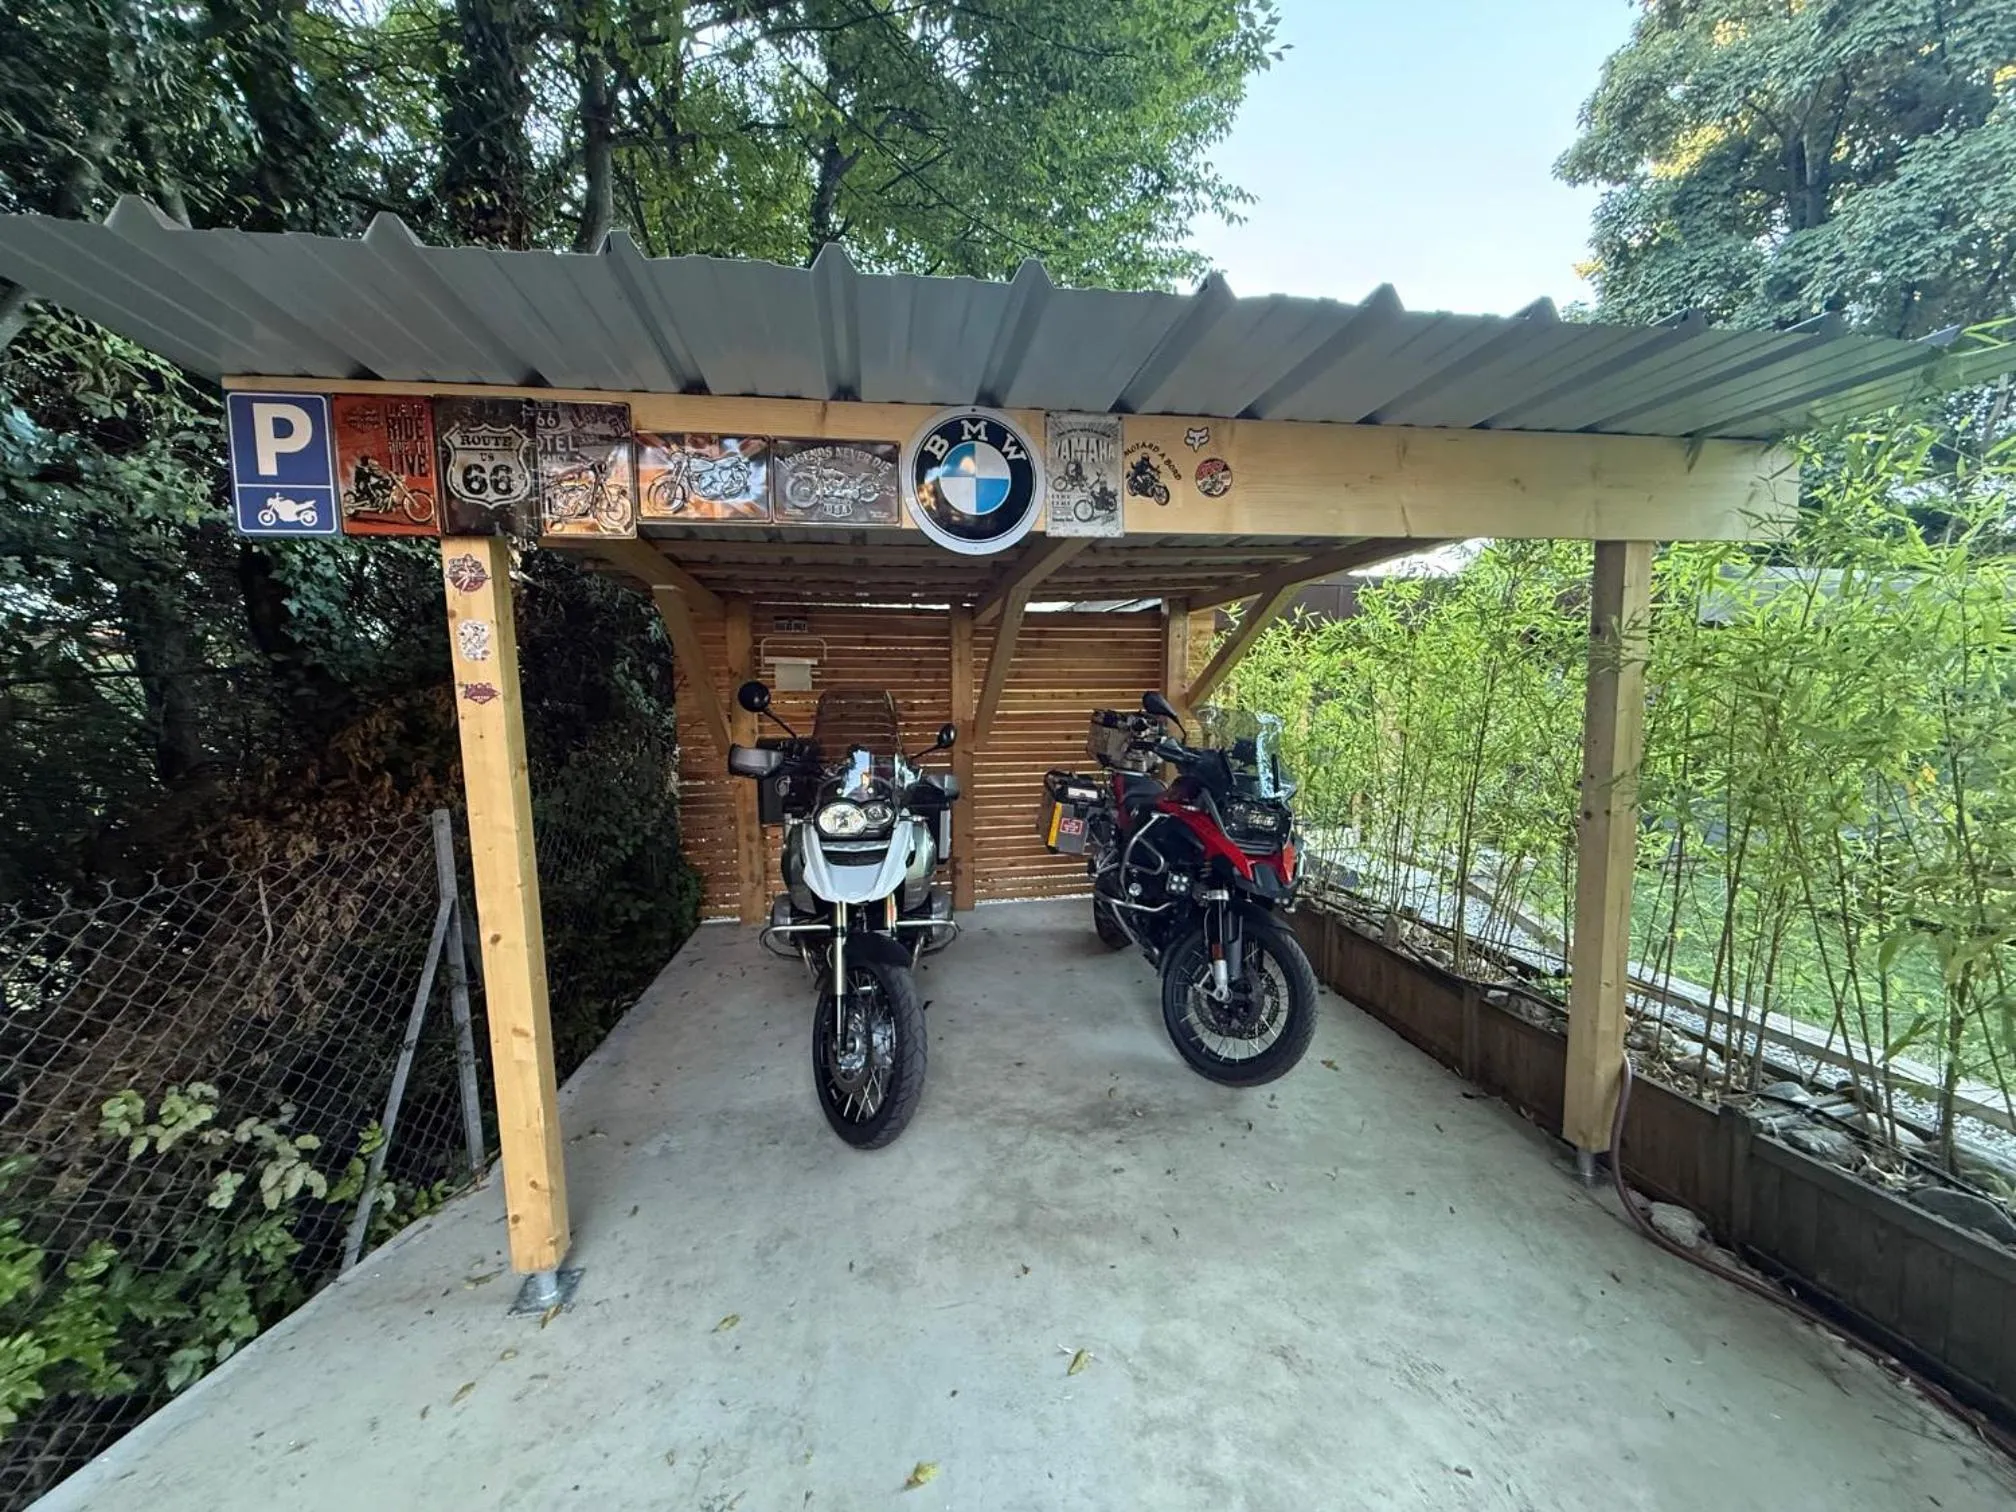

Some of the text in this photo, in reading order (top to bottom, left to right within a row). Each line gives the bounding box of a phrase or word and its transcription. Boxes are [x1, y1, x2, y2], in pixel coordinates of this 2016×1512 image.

[387, 416, 425, 440] RIDE
[536, 412, 558, 428] 66
[252, 403, 313, 476] P
[460, 435, 513, 446] ROUTE
[536, 432, 579, 452] OTEL
[924, 419, 1028, 461] BMW
[1054, 437, 1118, 462] YAMAHA
[390, 454, 428, 477] LIVE
[480, 452, 496, 462] US
[774, 446, 894, 474] LEGENDS NEVER DIE
[1123, 441, 1160, 457] MOTARD
[1163, 458, 1183, 481] BORD
[462, 463, 514, 496] 66
[824, 503, 850, 515] USA
